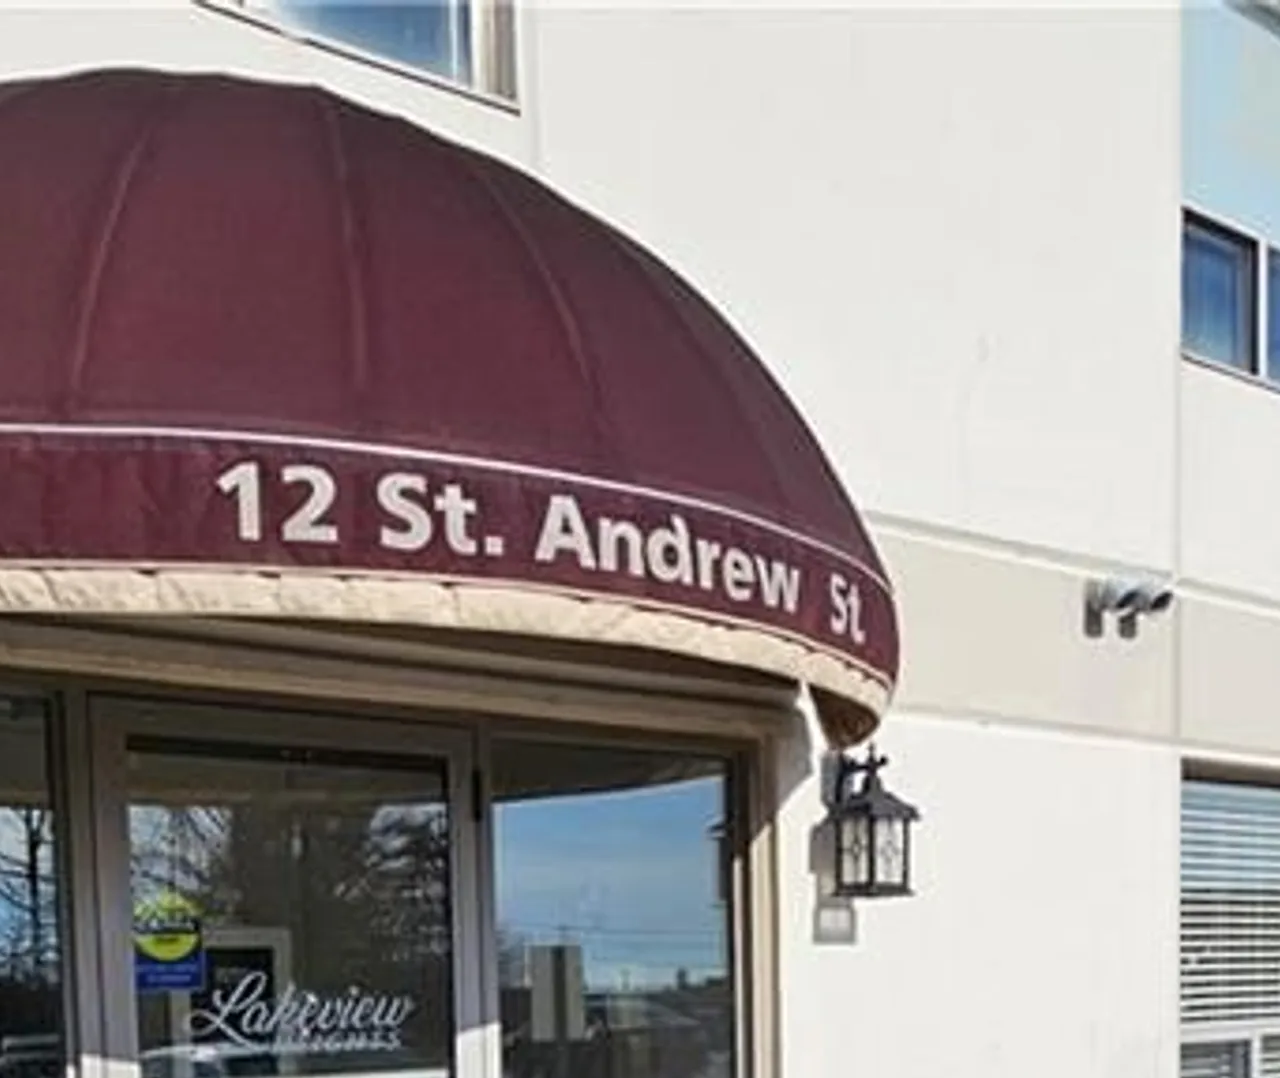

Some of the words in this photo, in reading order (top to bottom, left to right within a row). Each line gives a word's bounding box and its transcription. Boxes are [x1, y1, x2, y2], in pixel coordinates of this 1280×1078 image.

[216, 462, 339, 544] 12
[377, 473, 505, 556] St.
[534, 494, 801, 614] Andrew
[185, 971, 415, 1051] Lakeview
